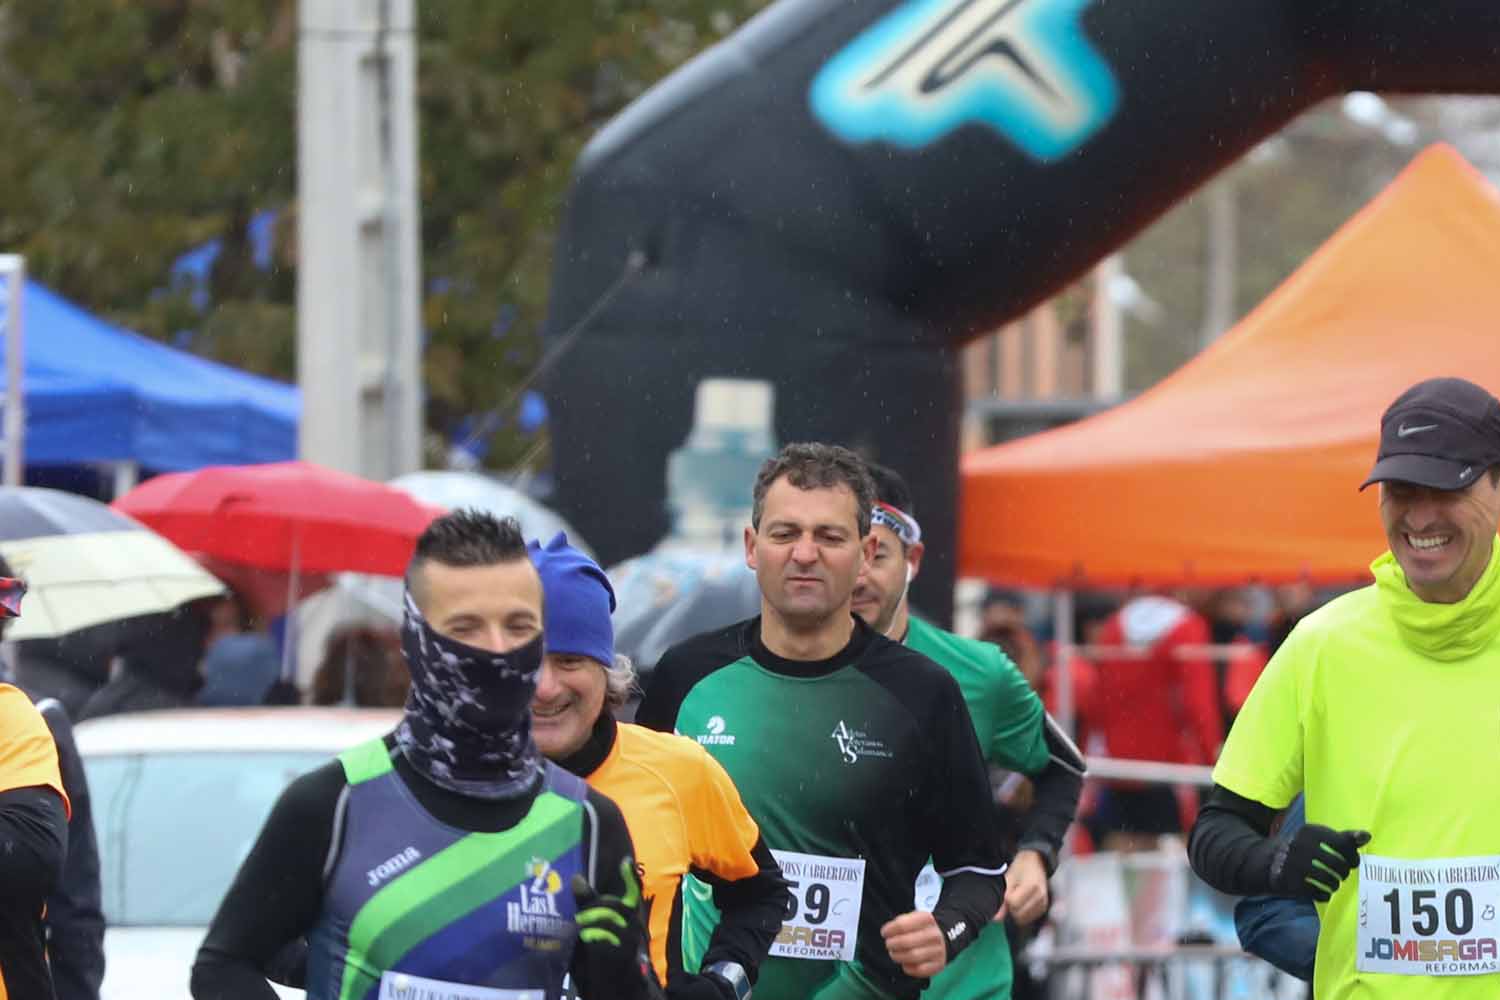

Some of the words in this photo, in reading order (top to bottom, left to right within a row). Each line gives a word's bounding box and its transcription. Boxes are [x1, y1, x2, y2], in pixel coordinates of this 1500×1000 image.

[697, 735, 736, 745] VIATOR
[1404, 867, 1436, 886] CROSS
[785, 880, 831, 925] 59
[1383, 887, 1475, 936] 150
[779, 944, 842, 959] REFORMAS
[1365, 937, 1498, 962] JOMISAGA
[1425, 961, 1498, 973] REFORMAS
